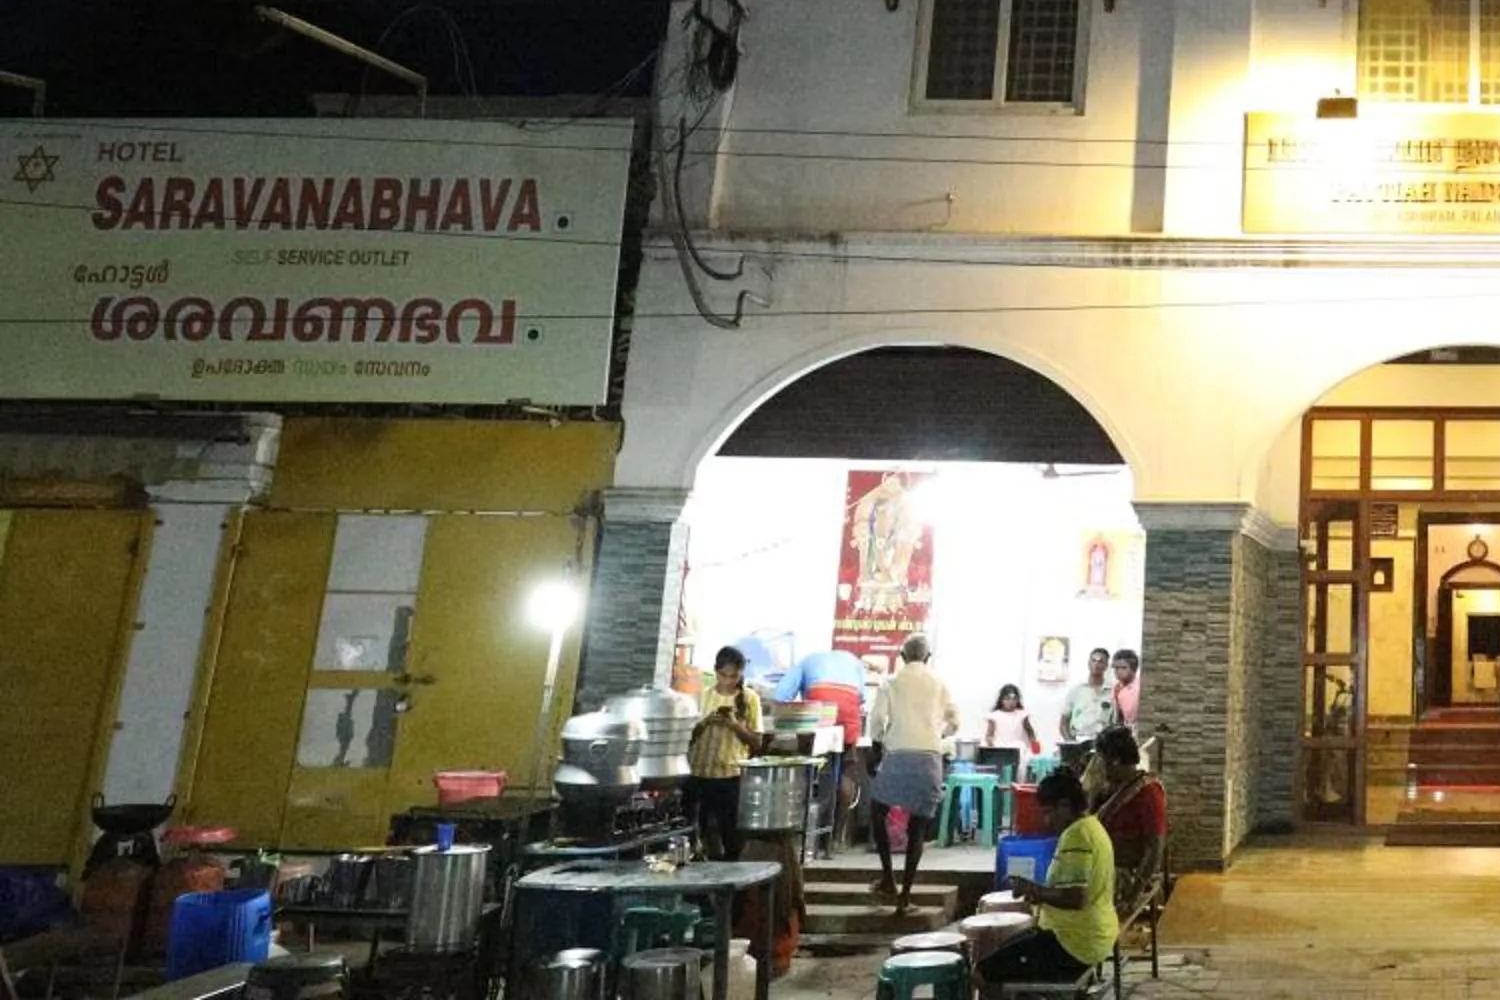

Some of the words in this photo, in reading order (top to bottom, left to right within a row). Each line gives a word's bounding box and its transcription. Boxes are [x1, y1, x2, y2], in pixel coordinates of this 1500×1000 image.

[97, 141, 183, 163] HOTEL
[91, 176, 542, 233] SARAVANABHAVA
[278, 249, 345, 266] SERVICE
[350, 250, 412, 267] OUTLET
[91, 296, 517, 345] ശരവണഭവ
